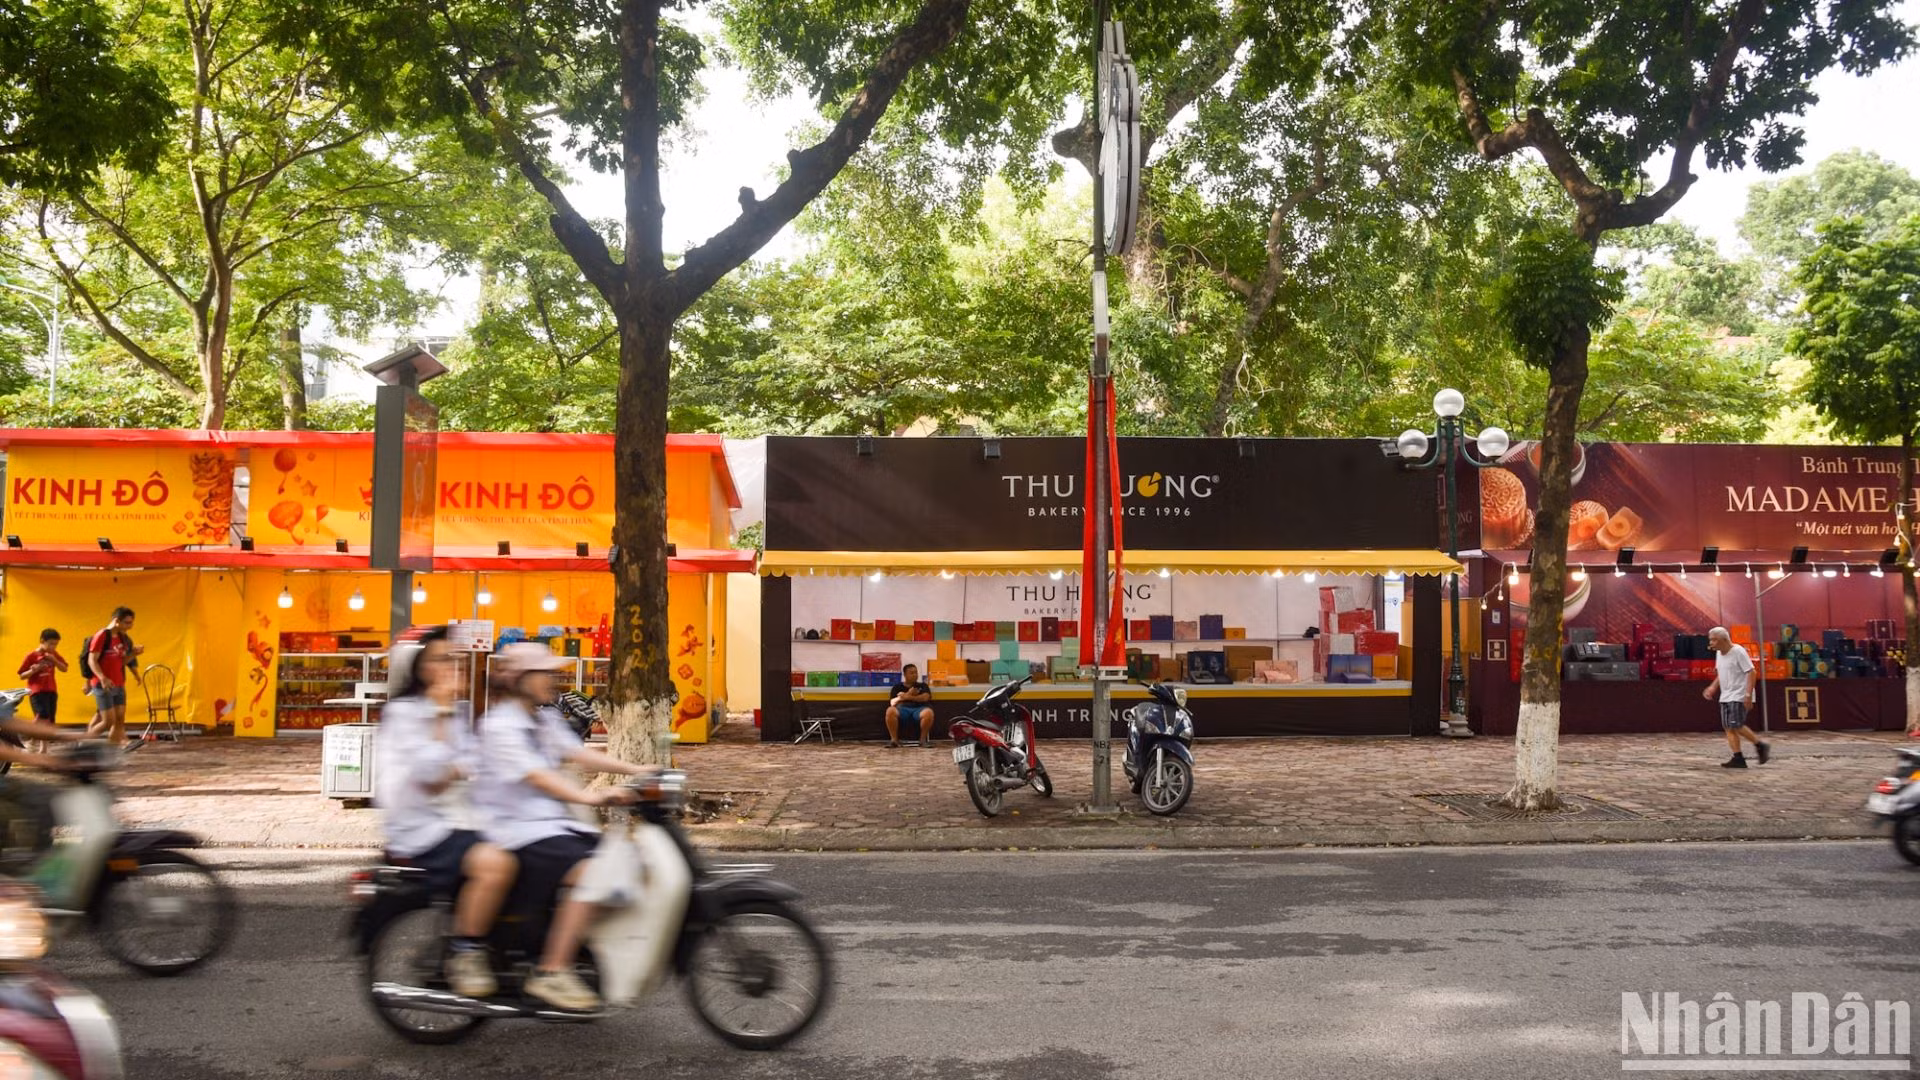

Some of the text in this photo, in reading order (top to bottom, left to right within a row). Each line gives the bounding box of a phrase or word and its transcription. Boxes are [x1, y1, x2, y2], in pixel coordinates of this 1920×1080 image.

[1801, 456, 1848, 474] Bánh
[13, 470, 169, 507] KINH ĐÔ
[440, 475, 595, 510] KINH ĐÔ
[1002, 474, 1074, 498] THU
[1725, 486, 1890, 513] MADAME
[1155, 507, 1191, 516] 1996
[1832, 521, 1853, 535] nét
[1006, 585, 1056, 601] THU
[1024, 607, 1066, 615] BAKERY
[1067, 708, 1134, 722] TRNG
